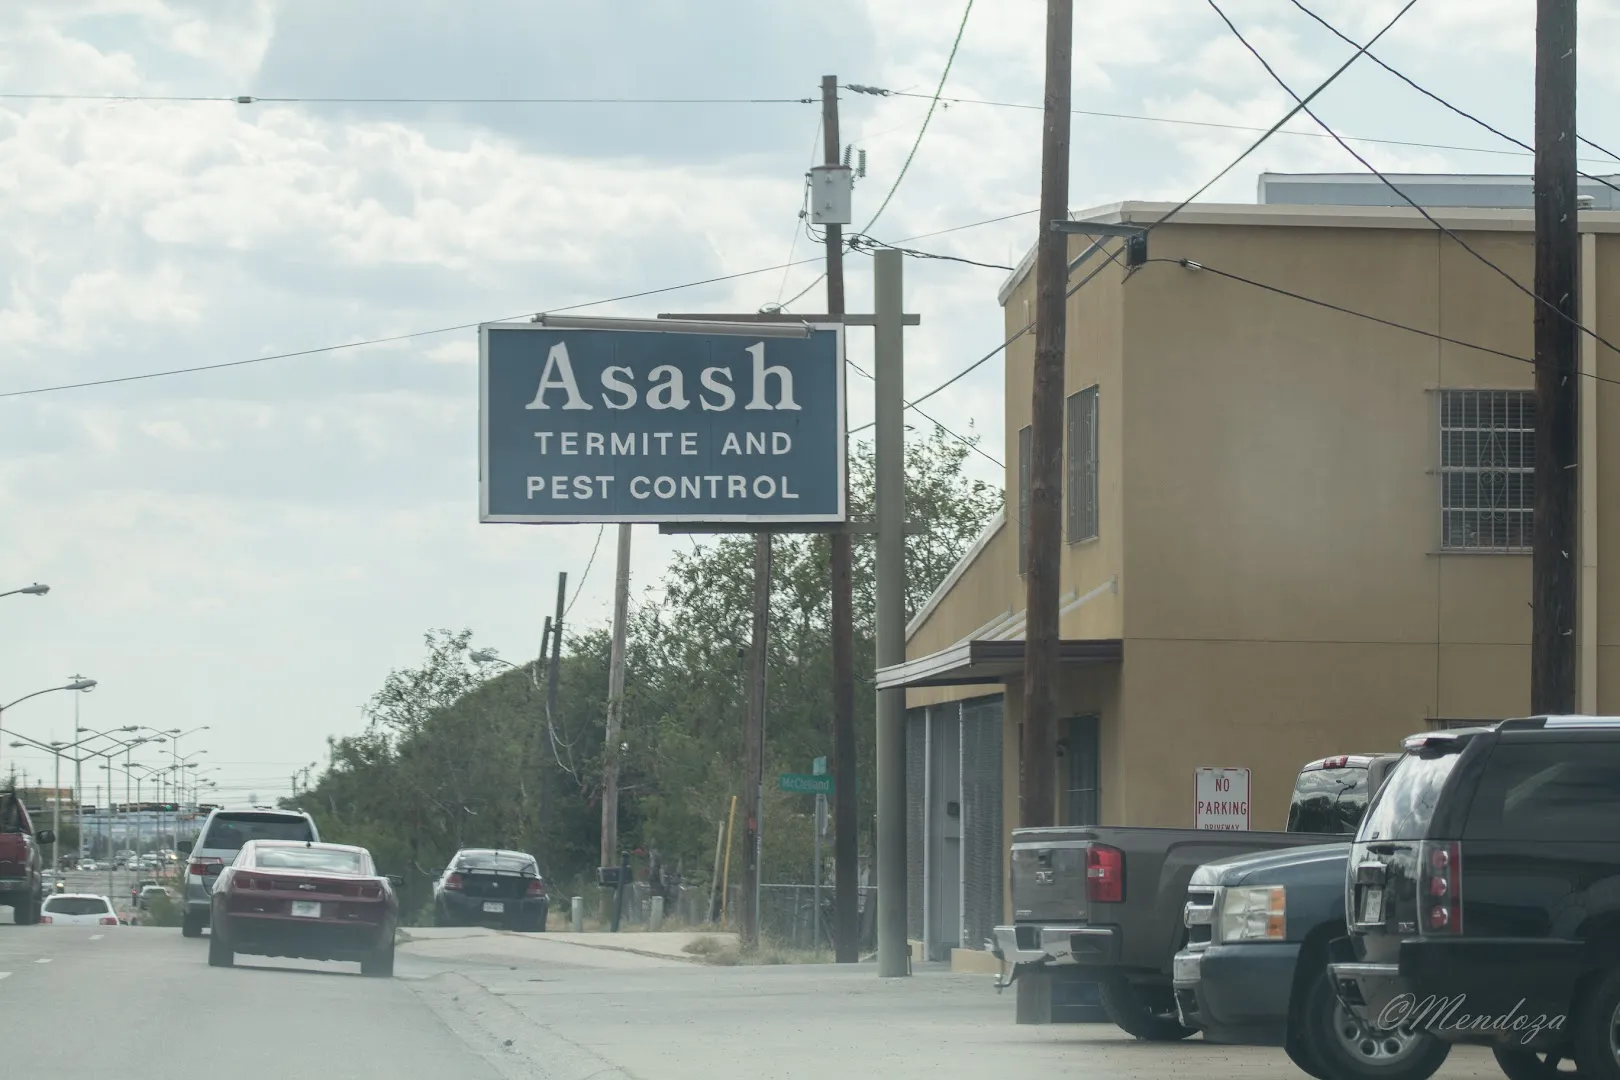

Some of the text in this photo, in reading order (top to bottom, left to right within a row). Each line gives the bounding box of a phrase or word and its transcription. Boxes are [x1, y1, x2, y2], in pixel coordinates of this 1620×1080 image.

[525, 341, 802, 411] Asash
[534, 431, 792, 455] TERMITE AND
[527, 475, 799, 499] PEST CONTROL
[1215, 779, 1230, 792] NO
[1198, 801, 1247, 815] PARKING
